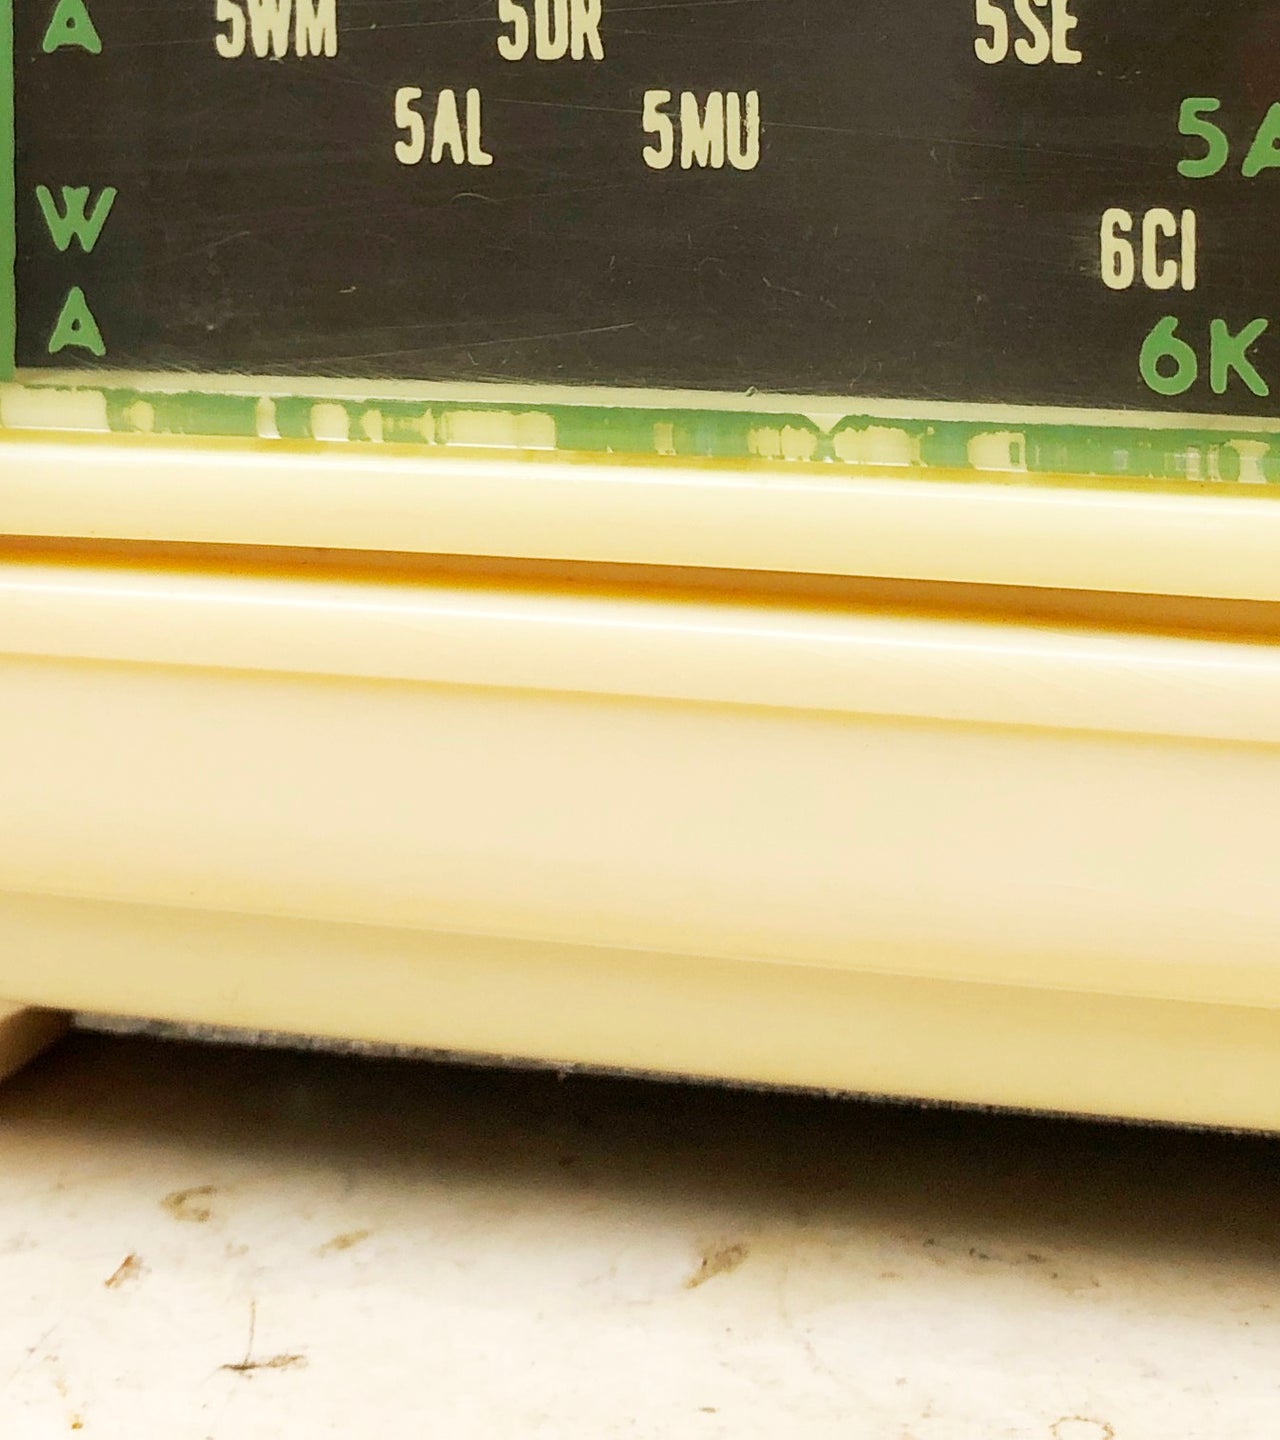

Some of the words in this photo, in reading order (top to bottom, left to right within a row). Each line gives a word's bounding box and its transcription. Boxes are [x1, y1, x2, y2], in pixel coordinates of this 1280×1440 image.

[394, 86, 494, 166] 5AL
[641, 89, 761, 171] 5MU
[1099, 207, 1197, 291] 6CI
